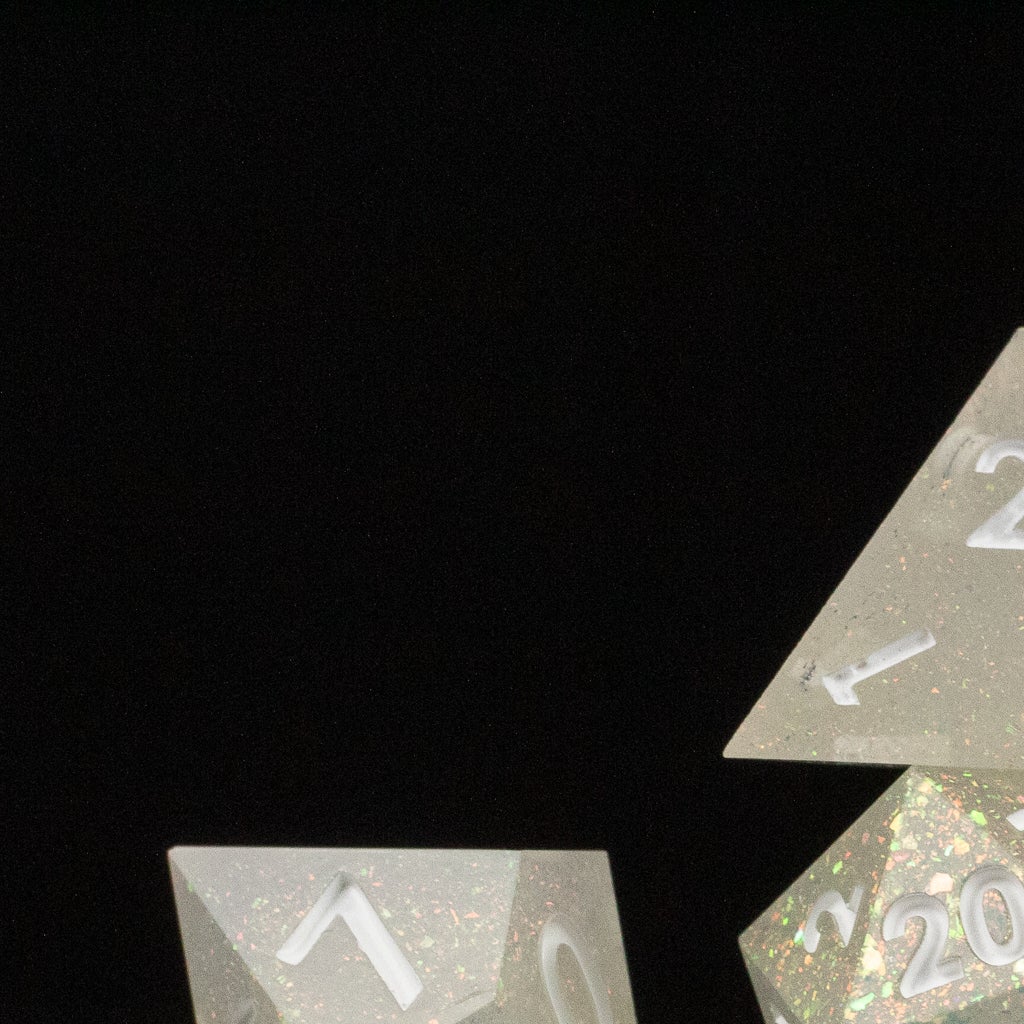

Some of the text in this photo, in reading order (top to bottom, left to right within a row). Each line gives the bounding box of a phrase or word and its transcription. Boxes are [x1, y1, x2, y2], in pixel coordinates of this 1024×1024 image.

[822, 628, 936, 706] 1
[275, 870, 424, 1011] 7
[803, 884, 864, 954] 2
